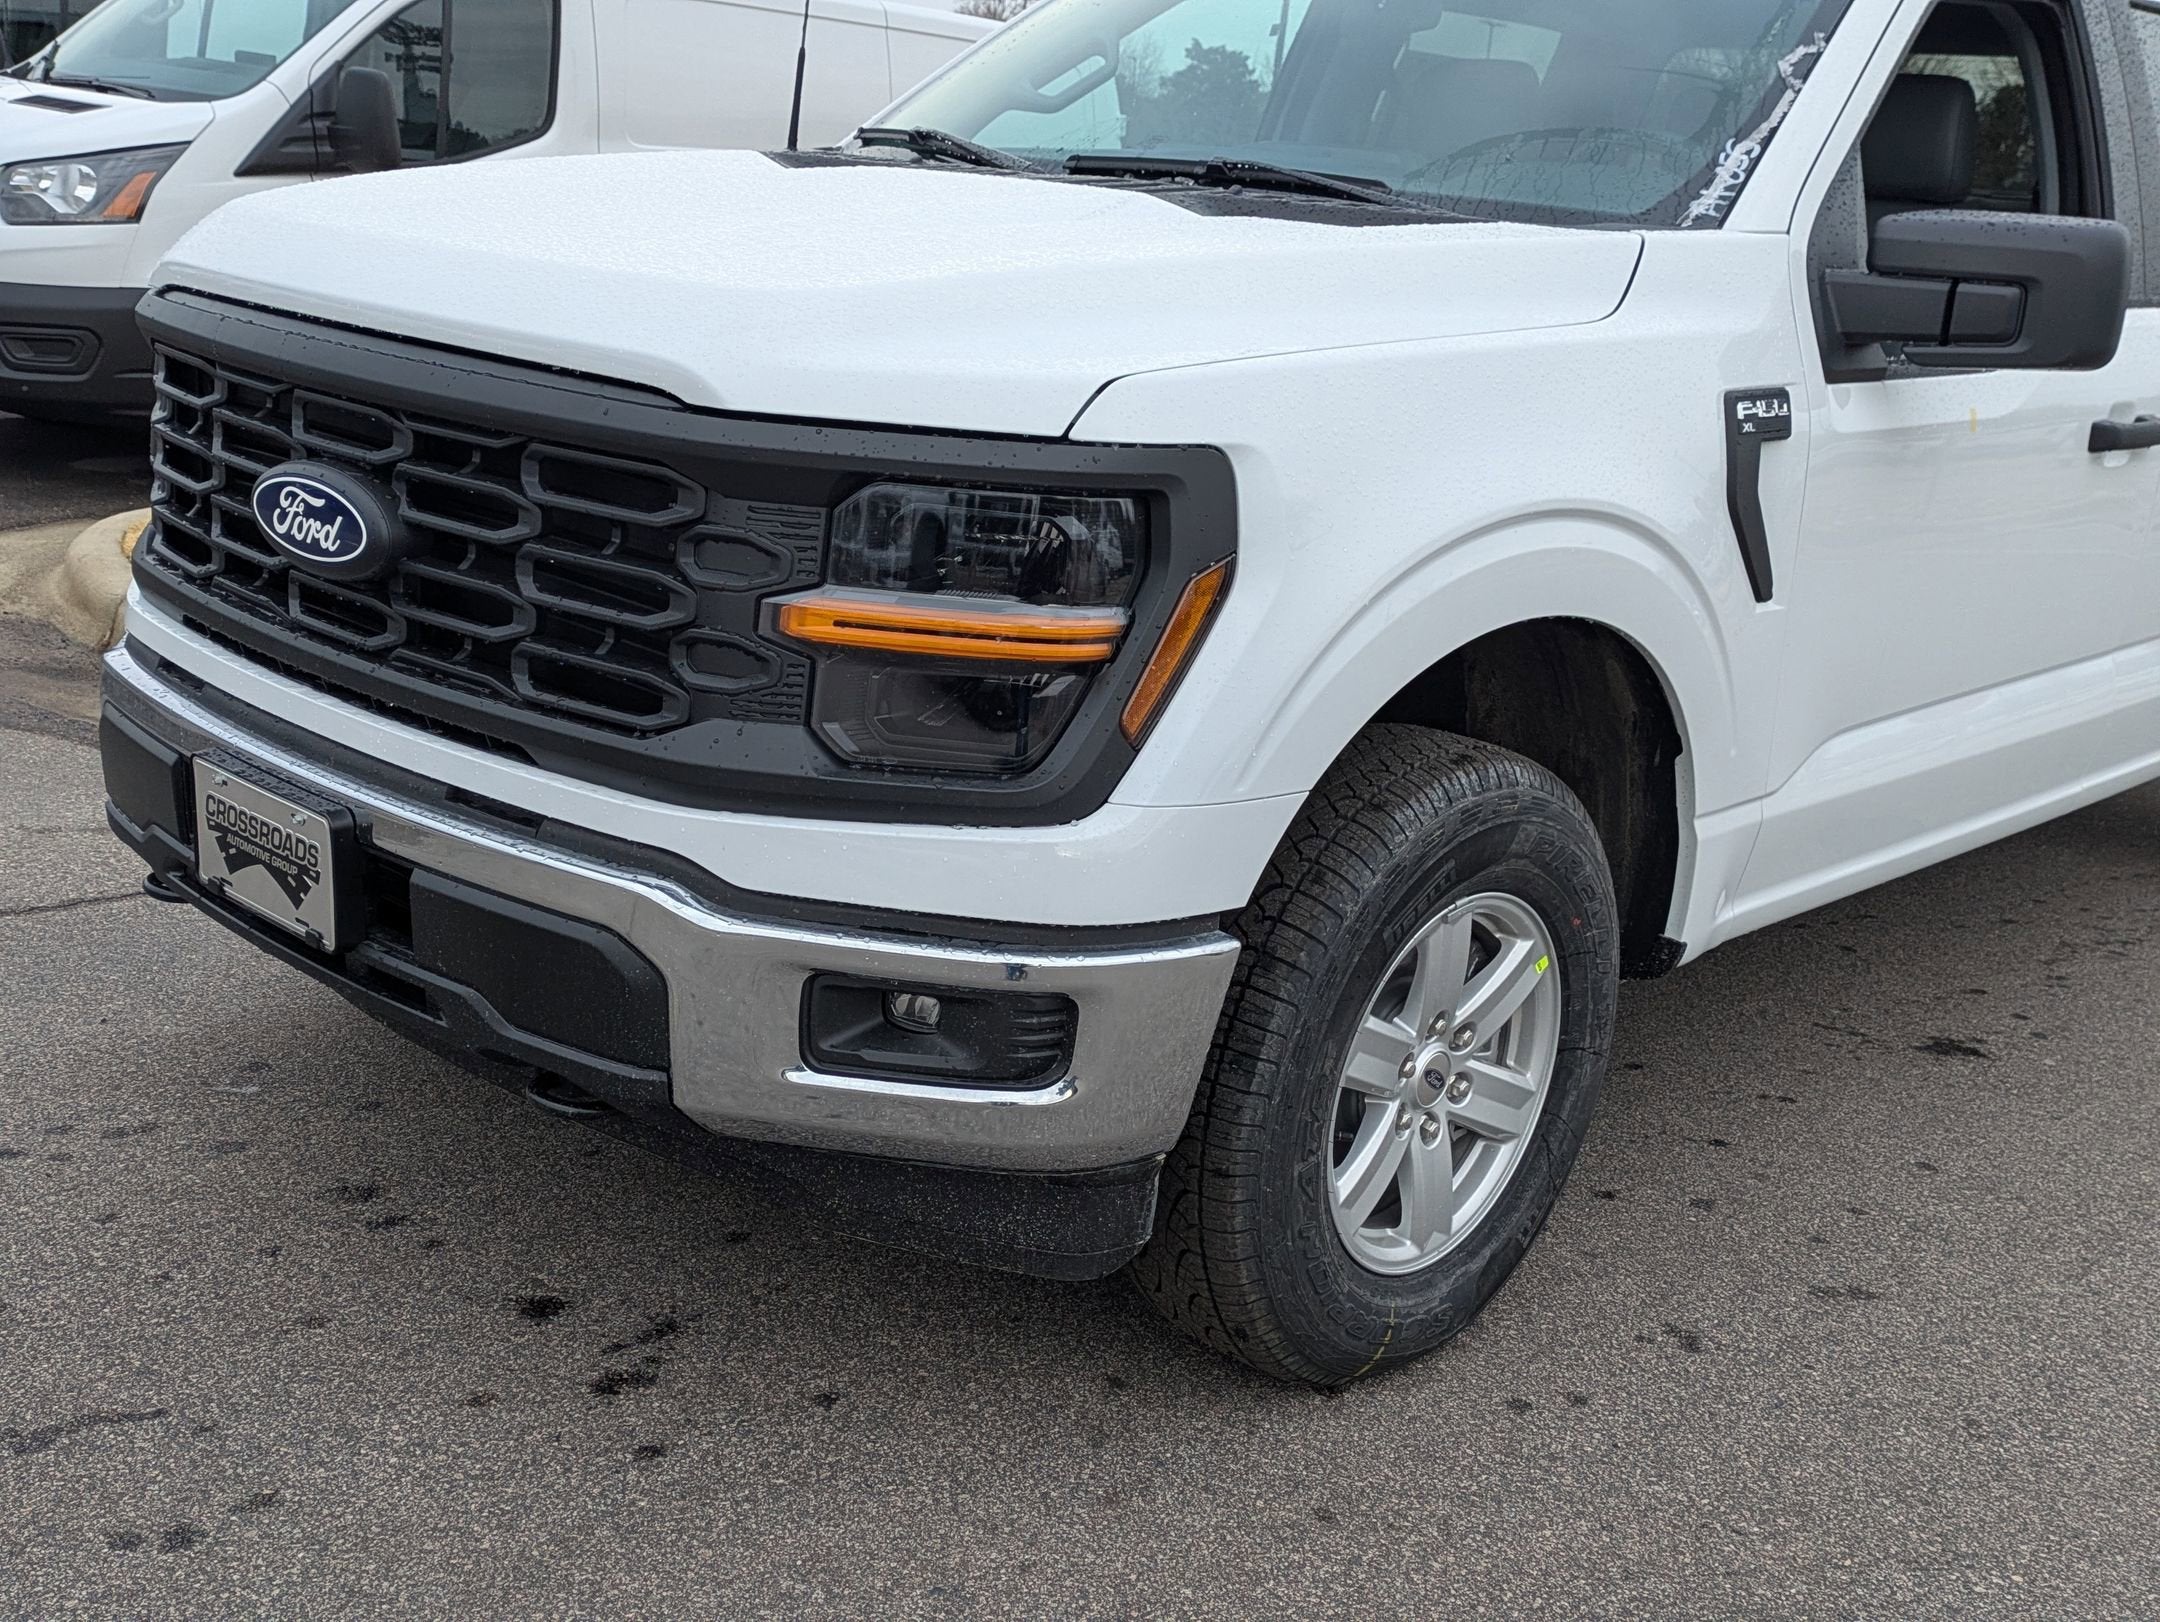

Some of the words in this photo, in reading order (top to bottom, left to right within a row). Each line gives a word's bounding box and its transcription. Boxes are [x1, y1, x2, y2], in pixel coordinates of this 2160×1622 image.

[1742, 422, 1756, 433] XL
[273, 486, 343, 552] Ford
[205, 794, 320, 871] CROSSROADS
[226, 833, 271, 864] AUTOMOTIVE
[271, 855, 298, 876] GROUP
[1427, 1072, 1443, 1088] Ford
